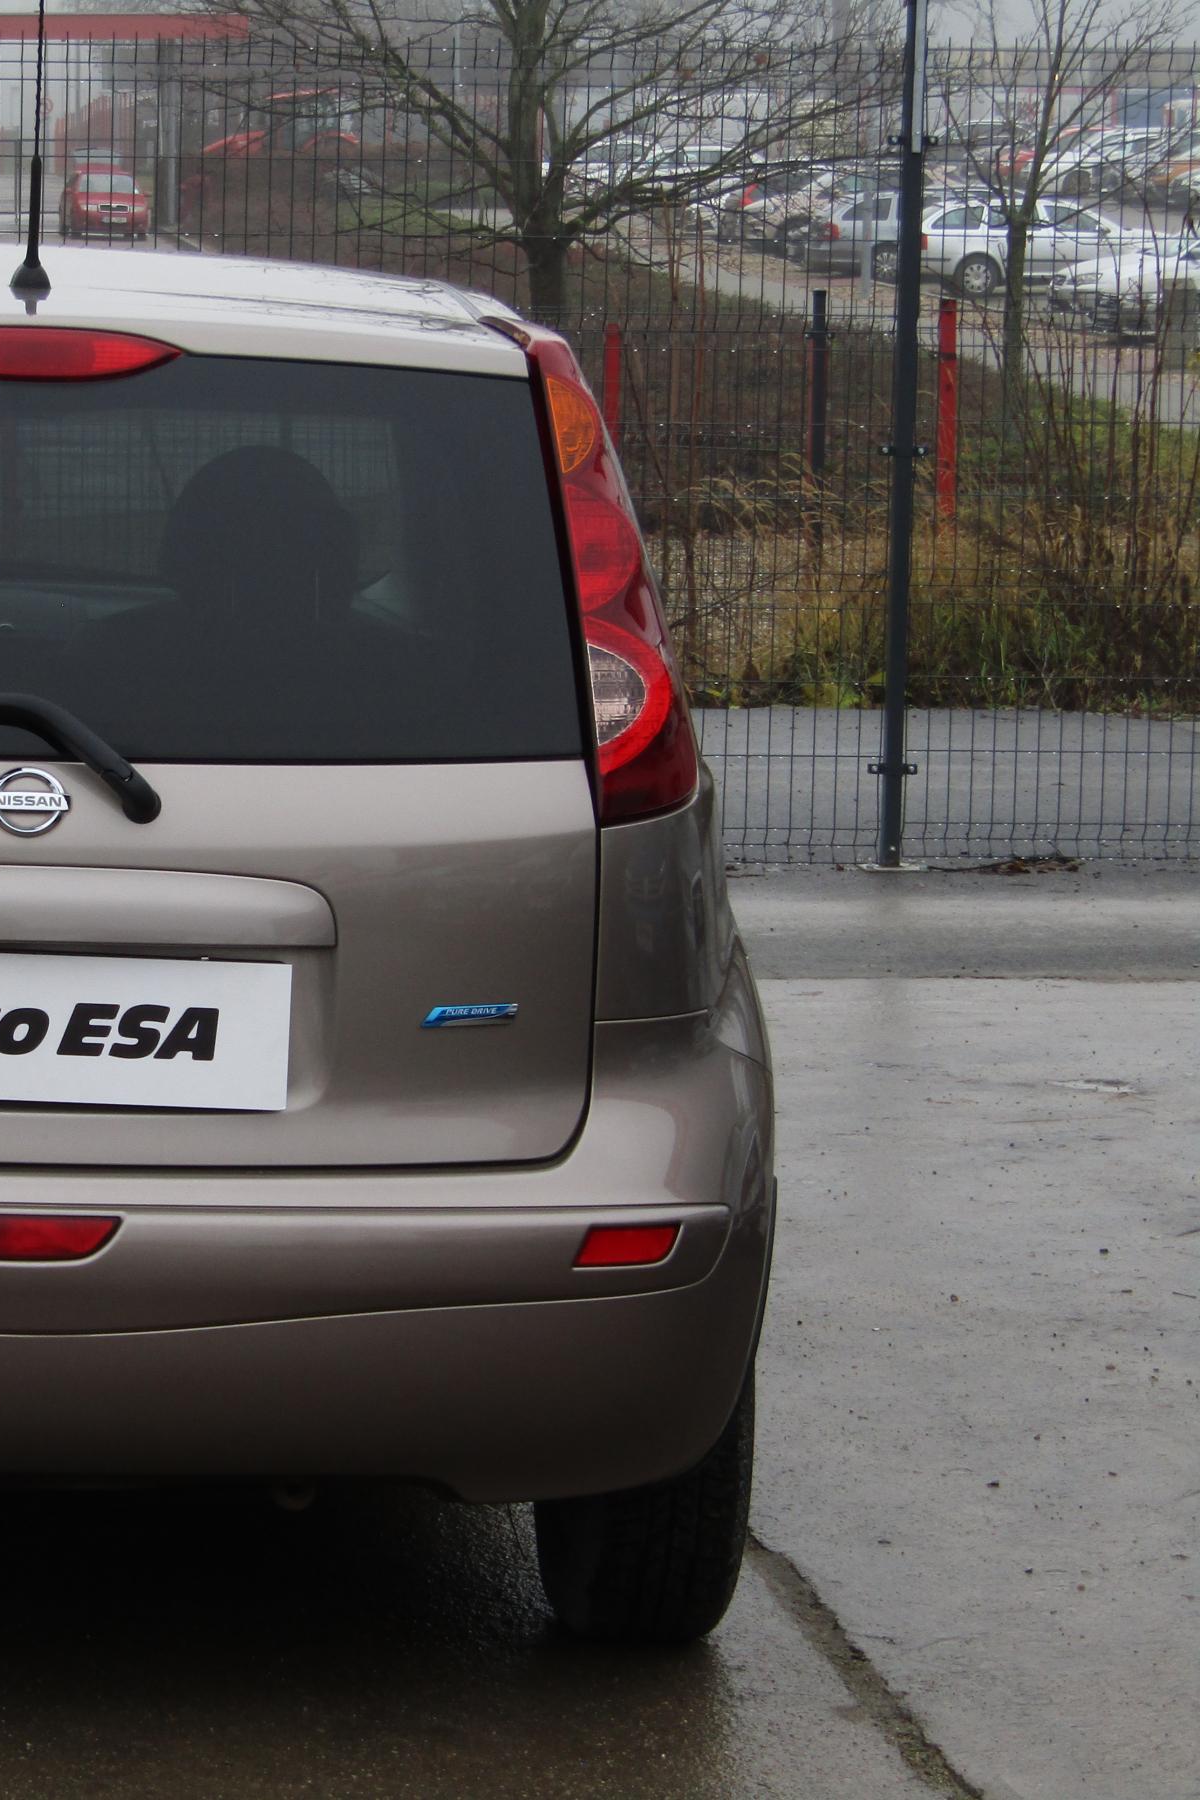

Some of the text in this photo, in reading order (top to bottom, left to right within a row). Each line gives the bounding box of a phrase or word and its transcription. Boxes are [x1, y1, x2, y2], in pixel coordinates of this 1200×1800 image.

[445, 1007, 498, 1016] PURE DRIVE
[56, 1002, 220, 1061] ESA
